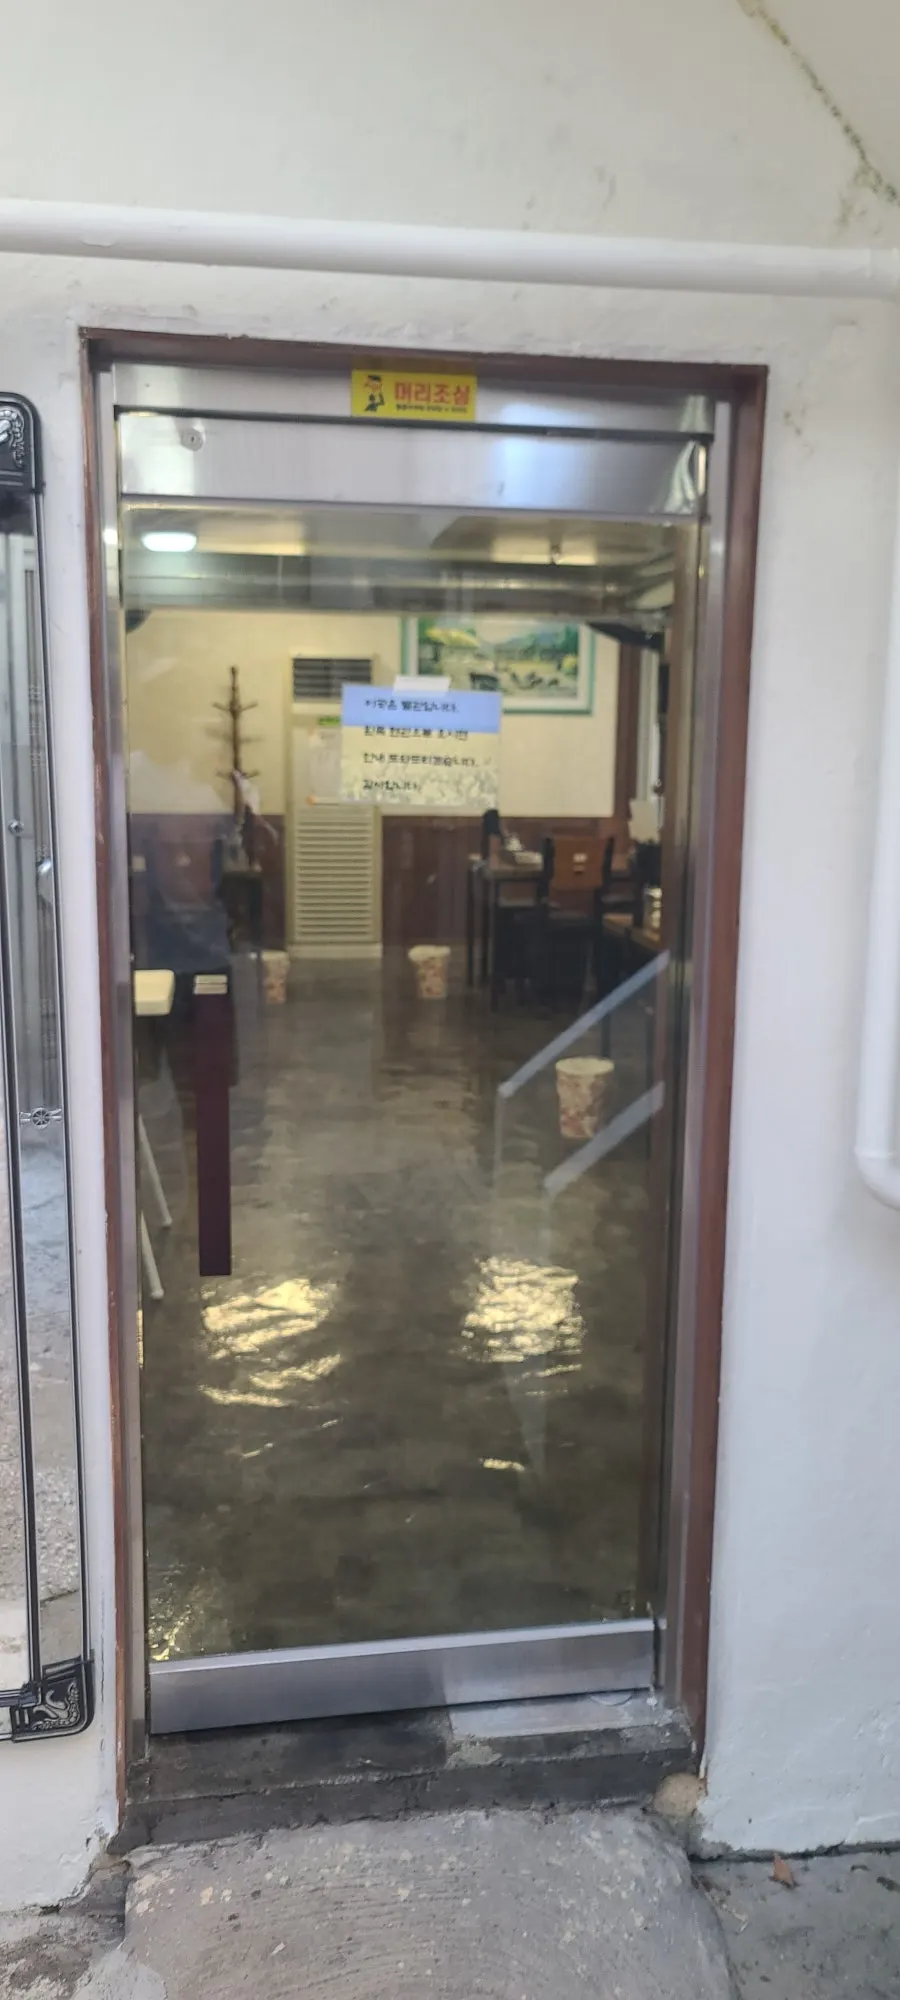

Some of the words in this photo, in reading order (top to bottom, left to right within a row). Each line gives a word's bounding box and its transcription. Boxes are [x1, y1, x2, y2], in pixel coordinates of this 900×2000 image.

[395, 382, 470, 405] 머리조심
[365, 700, 397, 711] 이곳은
[364, 753, 385, 763] 안내
